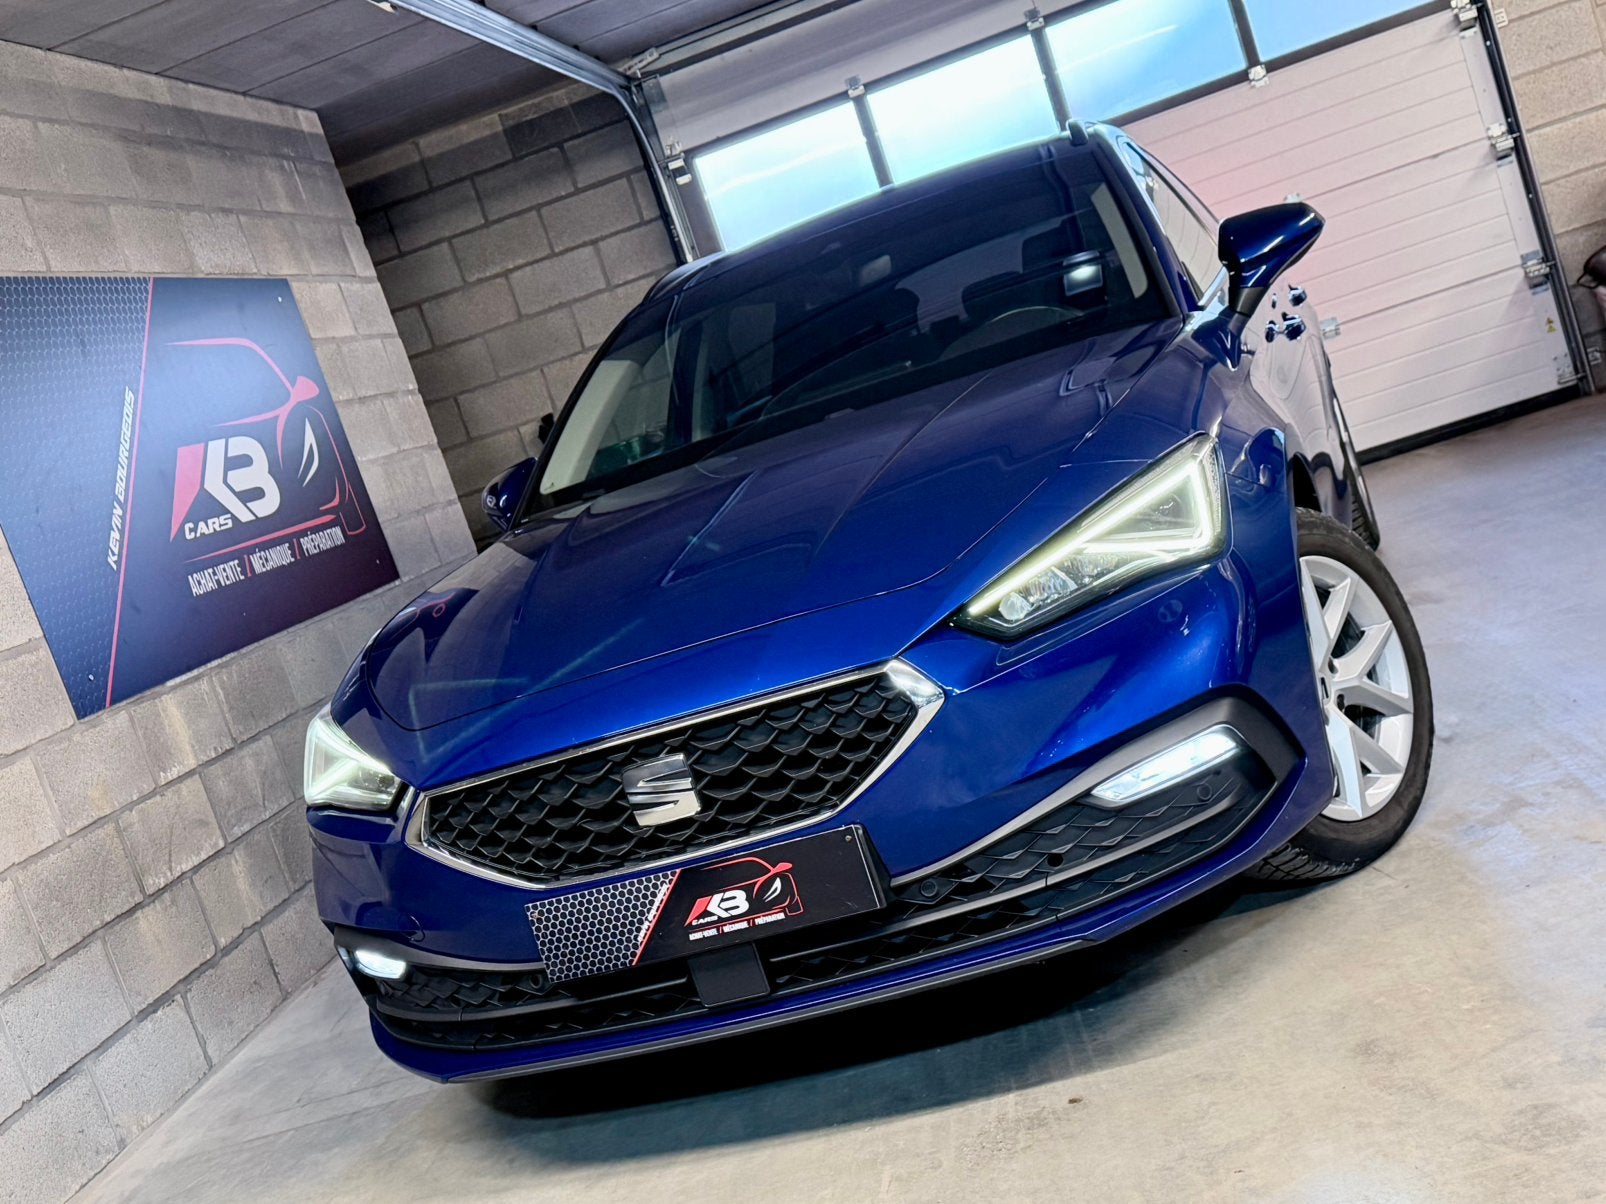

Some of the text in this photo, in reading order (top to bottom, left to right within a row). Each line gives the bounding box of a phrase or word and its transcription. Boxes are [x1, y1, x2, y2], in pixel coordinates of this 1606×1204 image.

[107, 386, 135, 571] KEVIN BOURGEOIS
[184, 513, 233, 540] CARS
[187, 559, 245, 597] ACHAT-VENTE
[250, 542, 295, 575] MÉCANIQUE
[300, 525, 346, 557] PRÉPARATION
